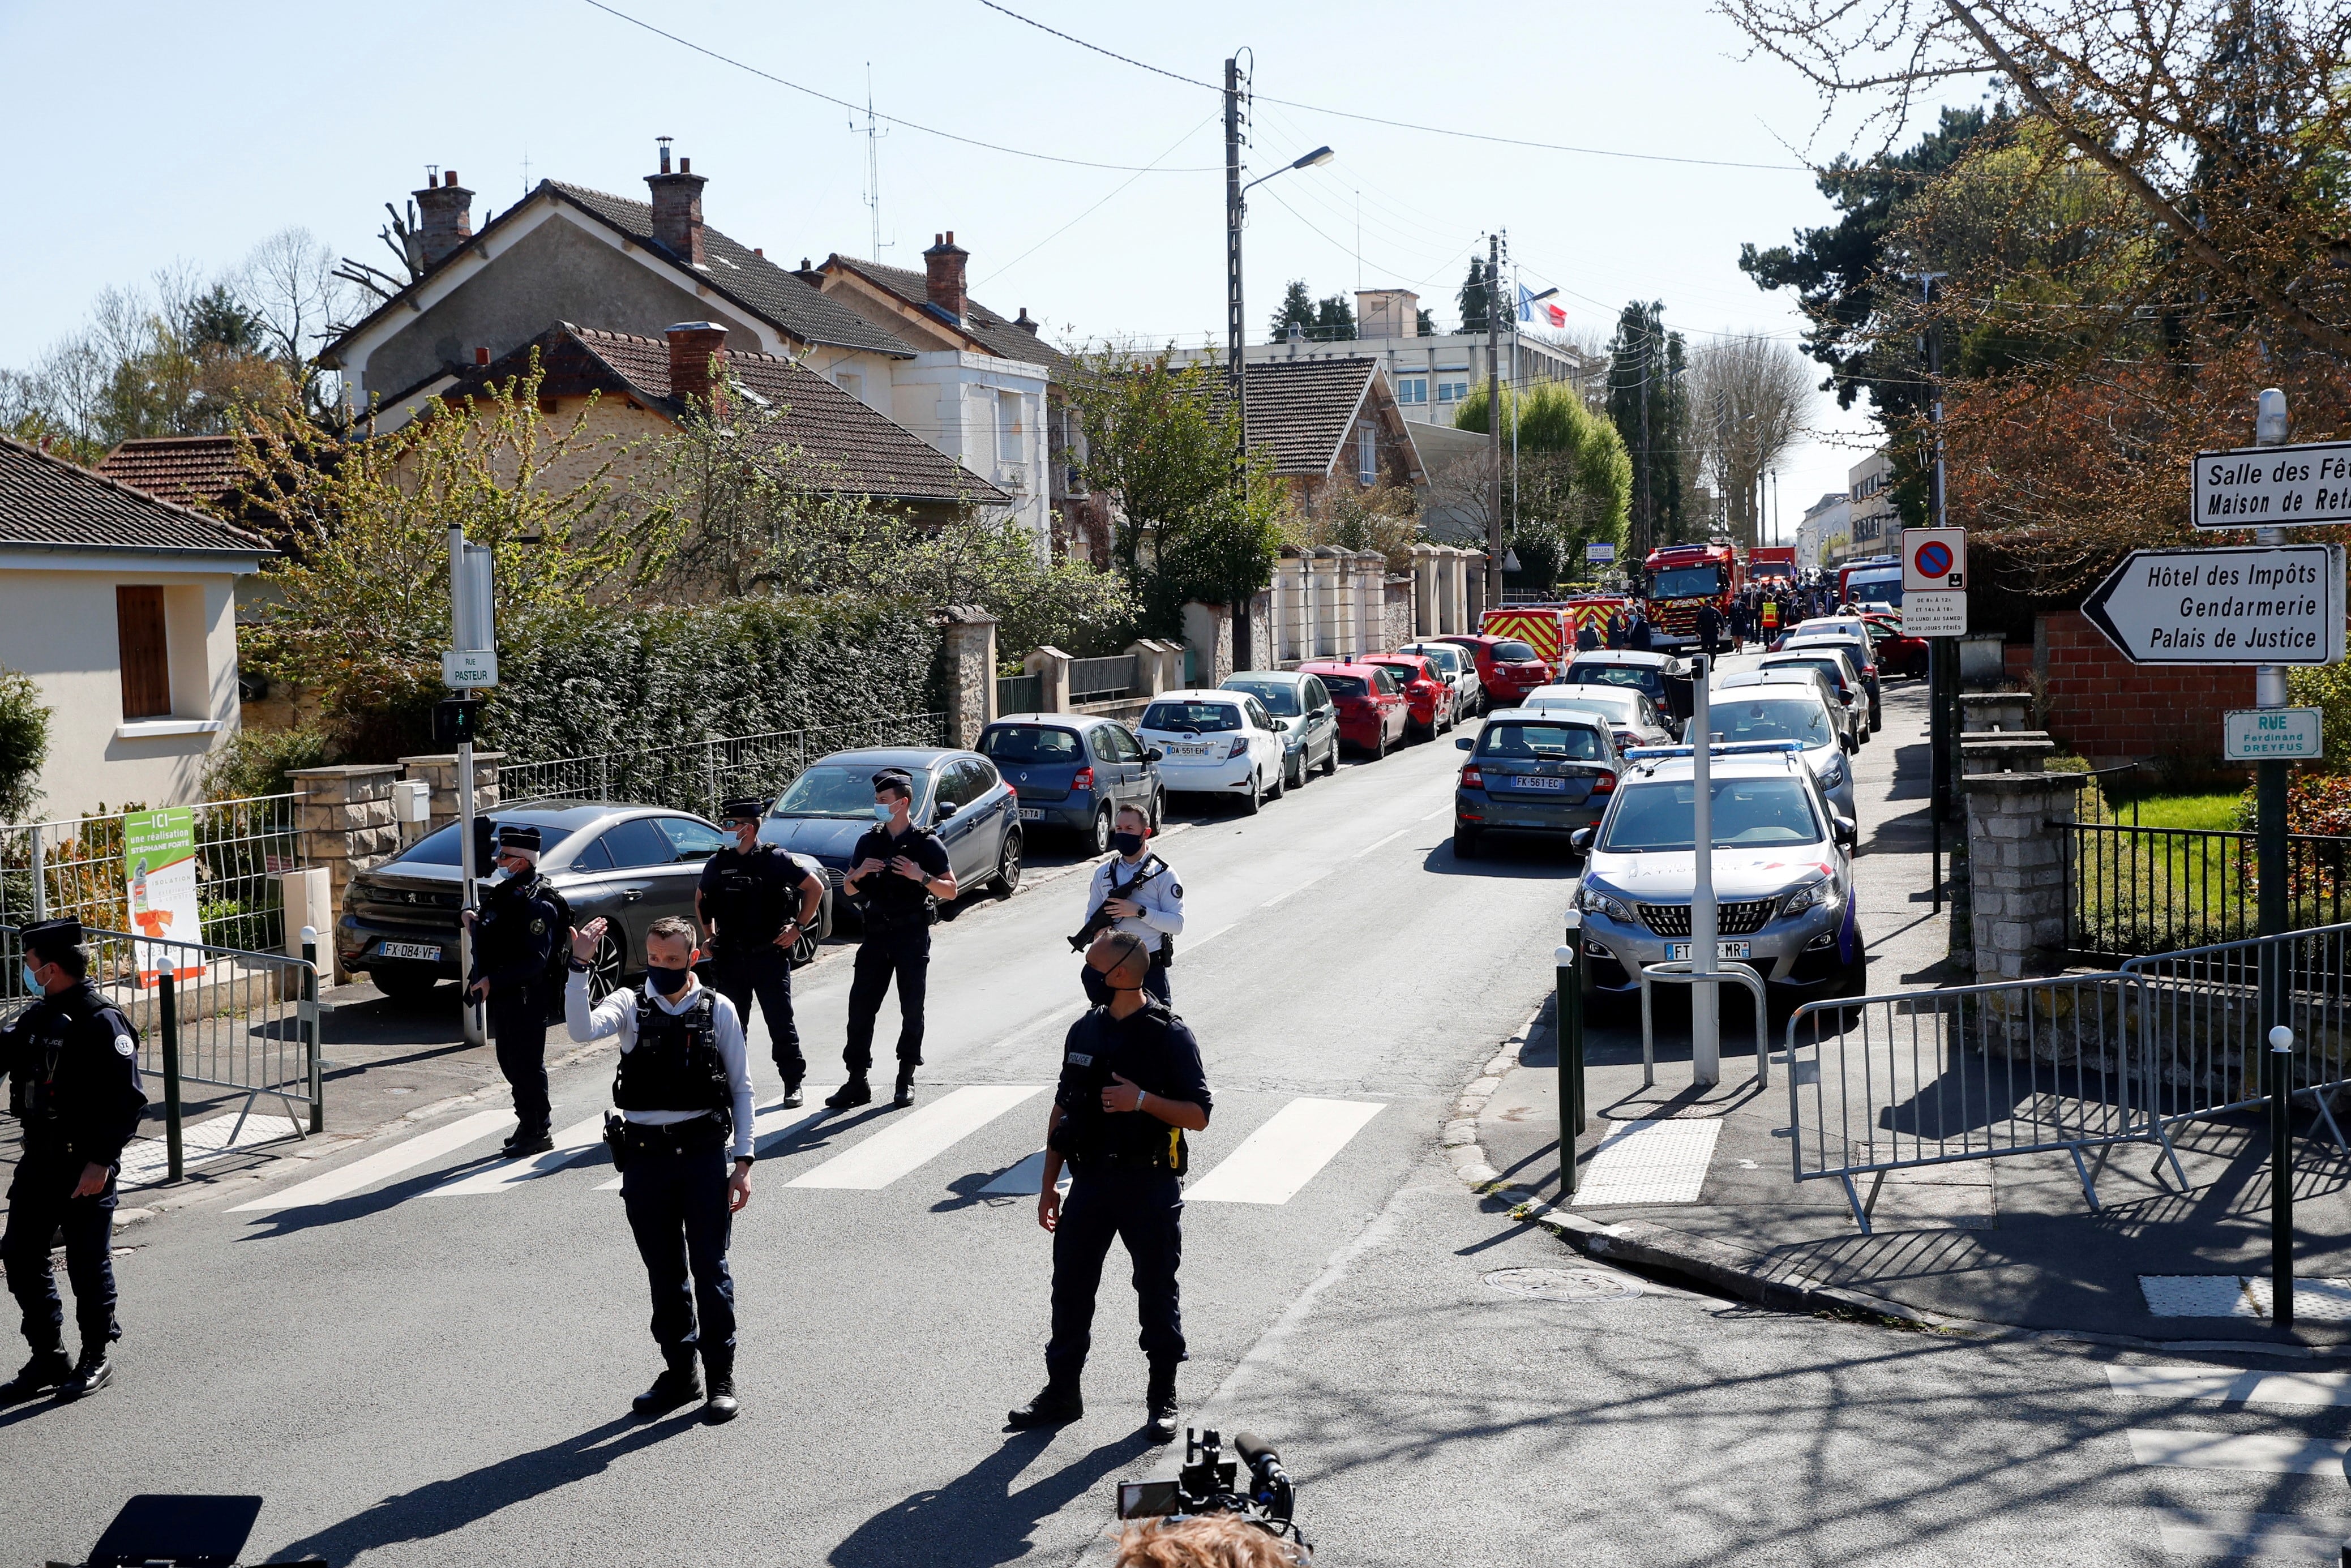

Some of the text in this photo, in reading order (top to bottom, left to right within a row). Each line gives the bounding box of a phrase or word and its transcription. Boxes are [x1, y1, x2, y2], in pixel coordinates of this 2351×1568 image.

[2208, 463, 2262, 486] Salle
[2272, 461, 2310, 482] des
[2207, 494, 2269, 515] Maison
[2283, 490, 2303, 512] de
[2148, 563, 2316, 590] Hôtel des Impôts
[2180, 594, 2316, 617] Gendarmerie
[2151, 627, 2316, 648] Palais de Justice
[455, 670, 487, 680] PASTEUR
[2259, 716, 2287, 730] RUE
[2244, 733, 2303, 742] Ferdinand
[2244, 743, 2303, 752] DREYFUS
[1517, 778, 1558, 788] FK-561-EC
[1019, 809, 1038, 818] 51-TA
[151, 813, 169, 829] ICI
[147, 829, 189, 842] réalisation
[131, 839, 190, 854] STÉPHANE FORTÉ
[152, 876, 191, 886] ISOLATION
[166, 893, 191, 902] combles
[386, 944, 435, 958] FX-084-VF
[1069, 1054, 1090, 1064] POLICE
